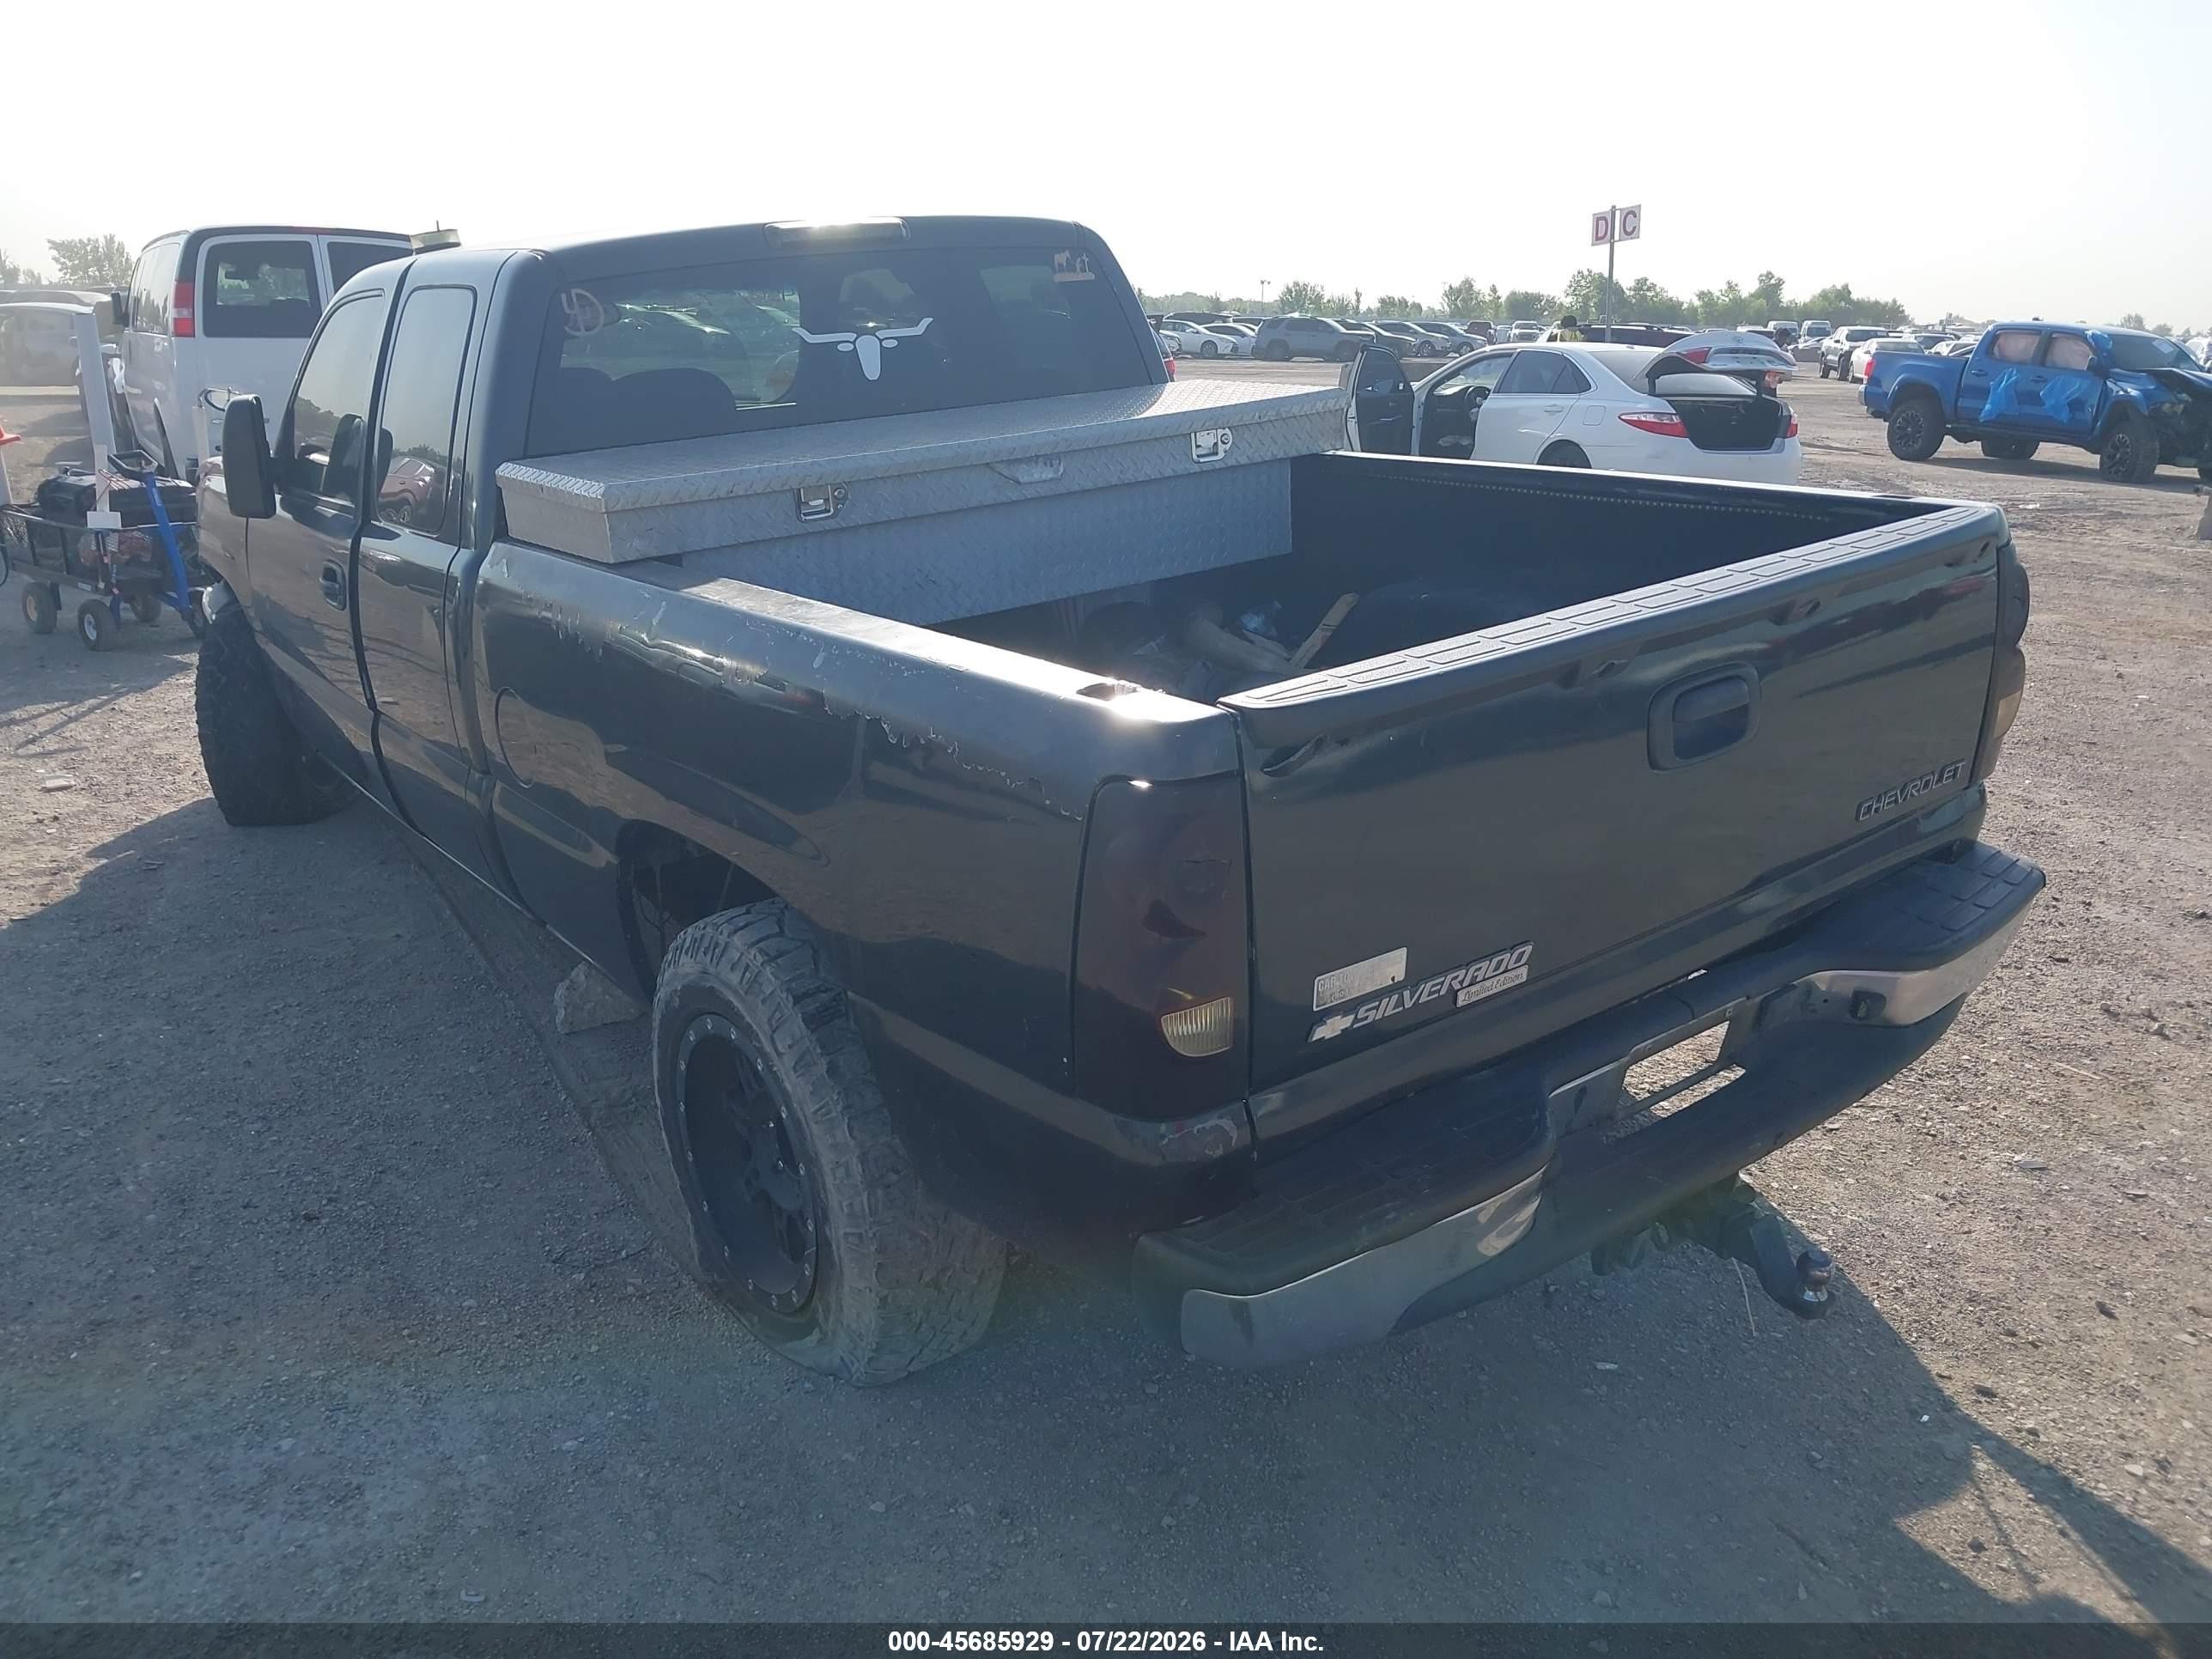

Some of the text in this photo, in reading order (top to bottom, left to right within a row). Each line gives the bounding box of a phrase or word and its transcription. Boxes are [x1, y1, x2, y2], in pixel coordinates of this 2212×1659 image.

[1595, 216, 1609, 241] D
[1622, 210, 1638, 236] C
[1858, 760, 1966, 822] CHEVROLET
[1352, 944, 1534, 1029] SILVERADO
[1462, 971, 1525, 1002] Limited Edition
